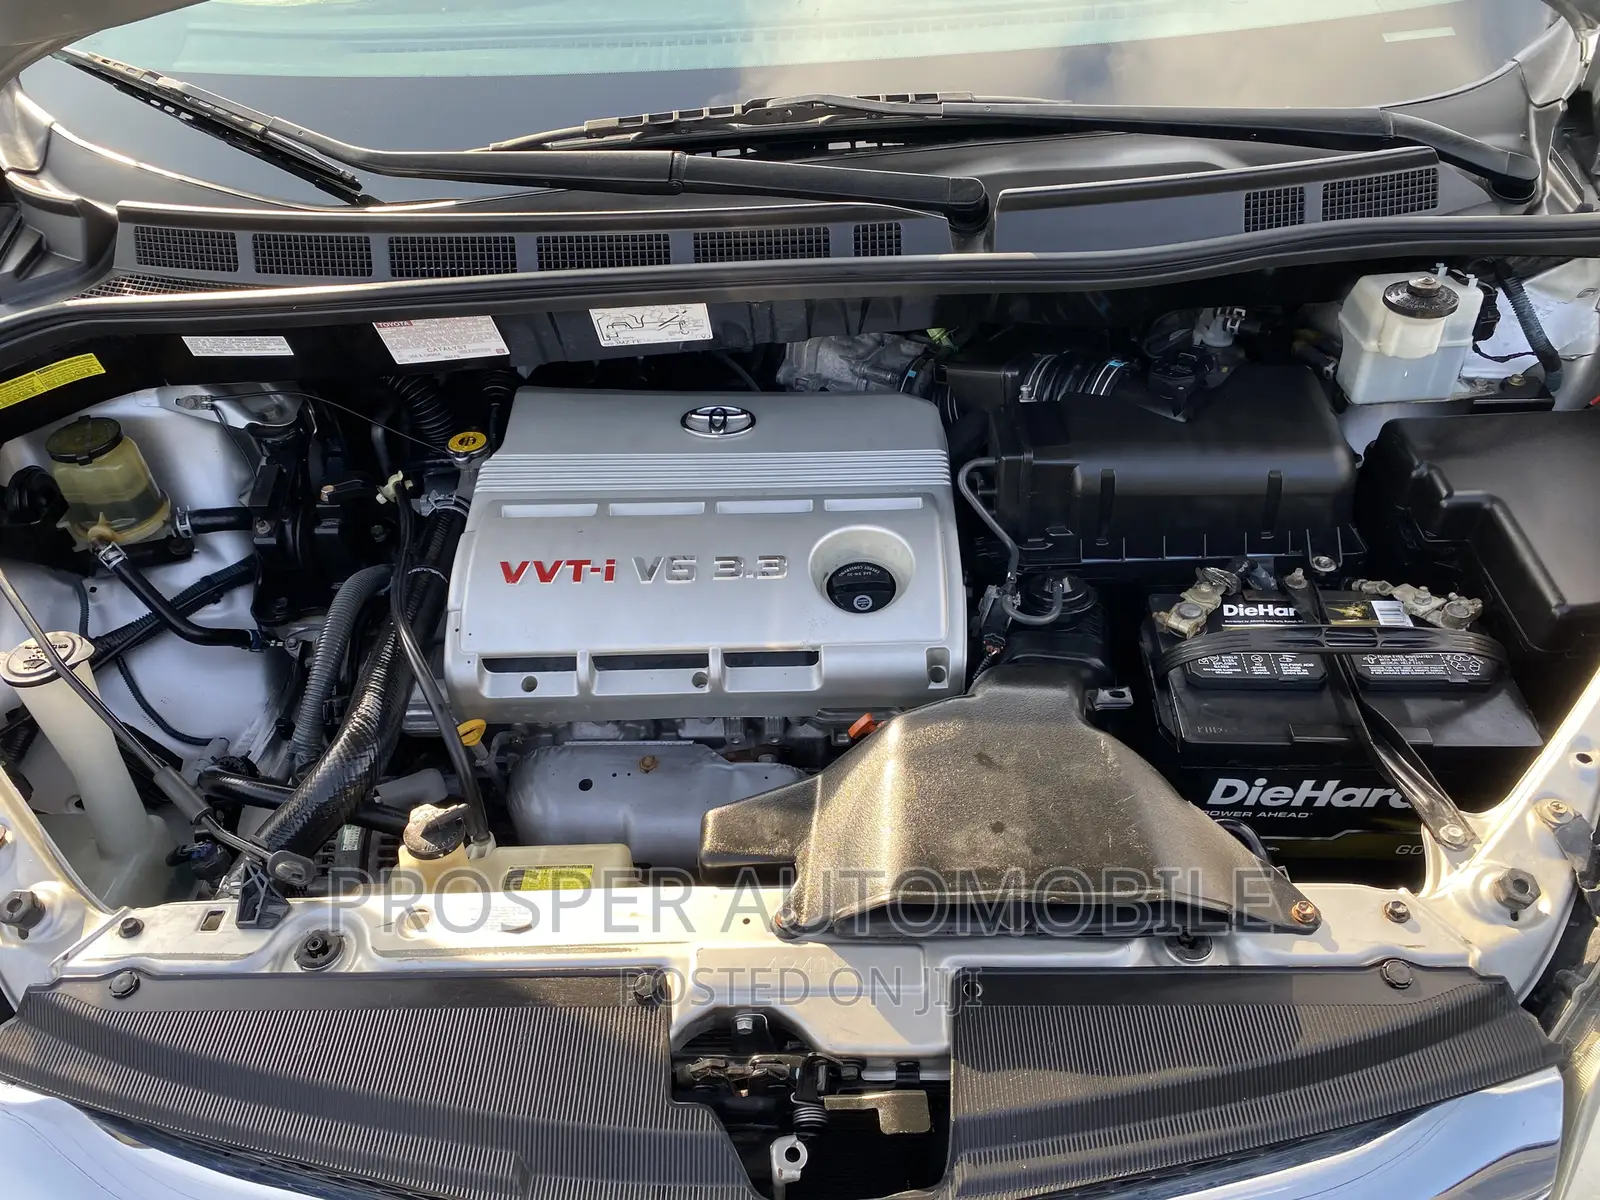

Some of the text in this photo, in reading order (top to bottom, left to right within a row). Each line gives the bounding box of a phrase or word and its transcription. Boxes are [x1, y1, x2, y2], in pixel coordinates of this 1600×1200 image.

[378, 320, 410, 328] TOYOTA
[426, 344, 468, 353] CATALYST
[499, 554, 788, 585] VVT-i V6 3.3
[1222, 603, 1298, 617] DieHar
[1256, 810, 1309, 819] AHEAD
